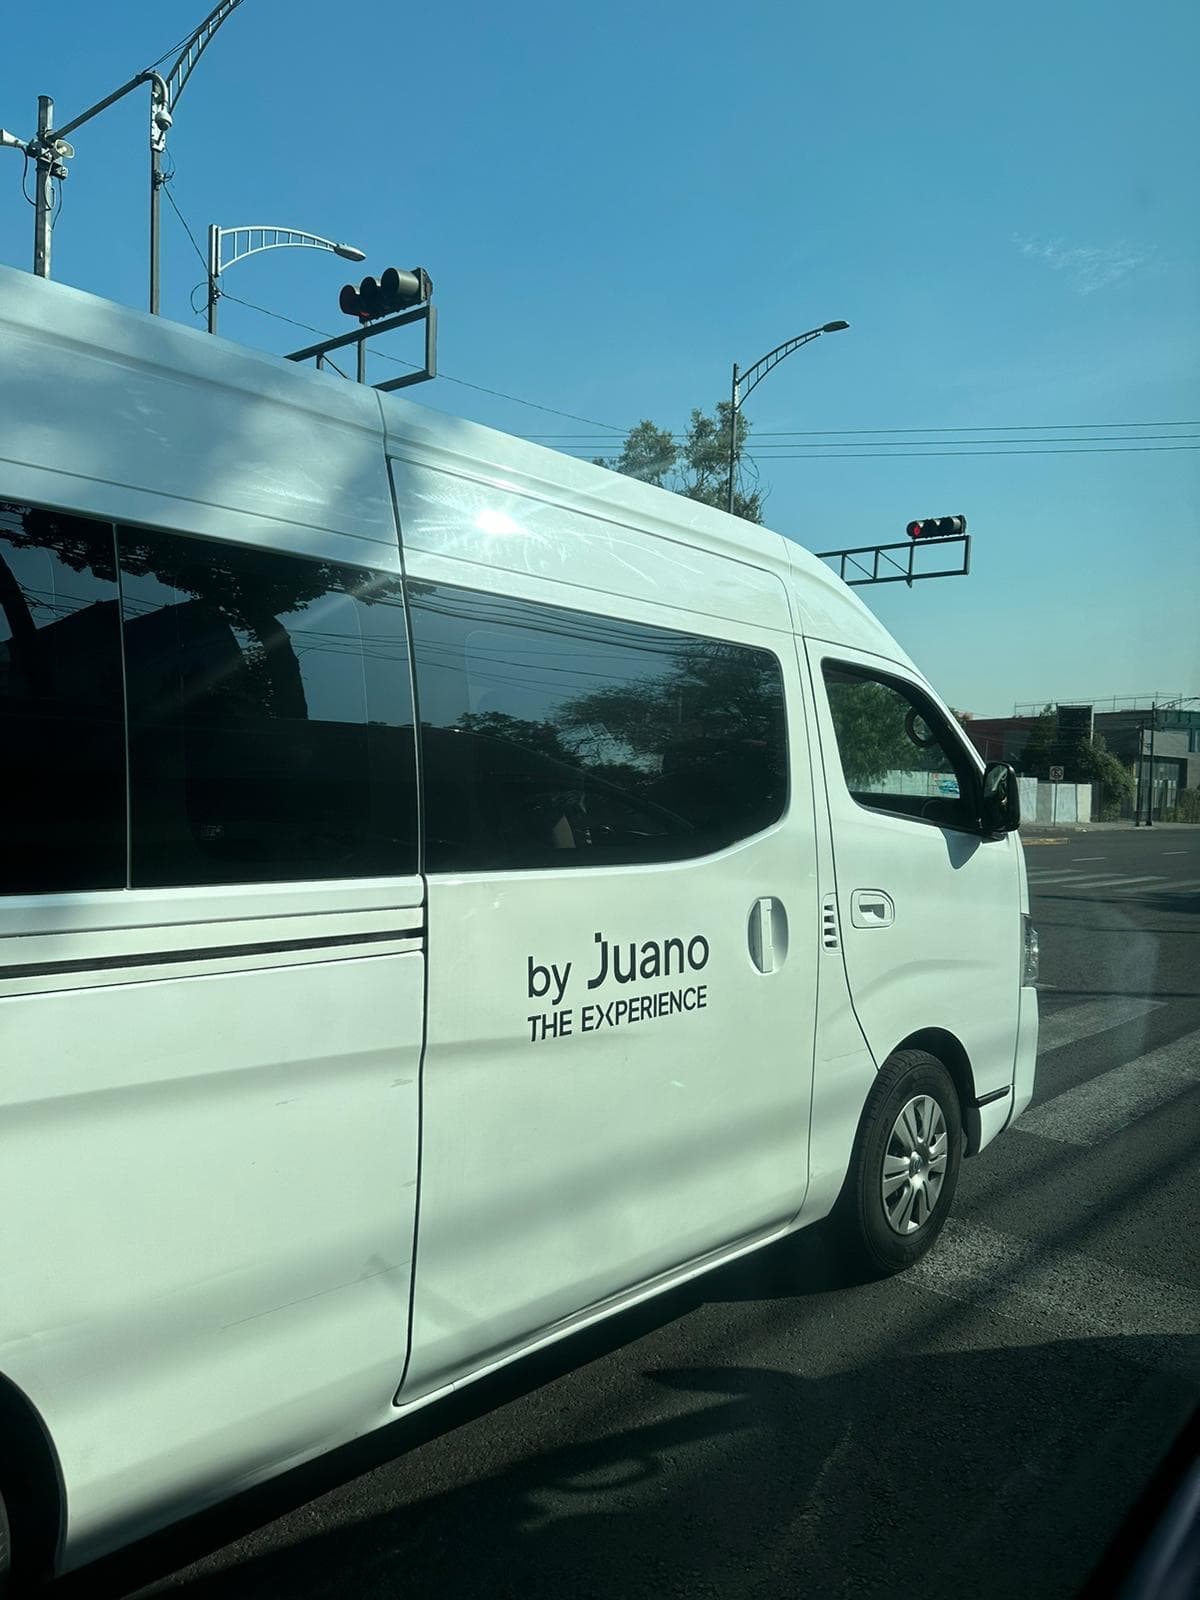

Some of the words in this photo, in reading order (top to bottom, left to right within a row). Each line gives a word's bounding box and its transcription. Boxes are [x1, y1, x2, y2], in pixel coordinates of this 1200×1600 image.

[527, 955, 572, 1006] by
[587, 932, 710, 990] Juano
[527, 1009, 573, 1042] THE
[581, 984, 708, 1032] EXPERIENCE
